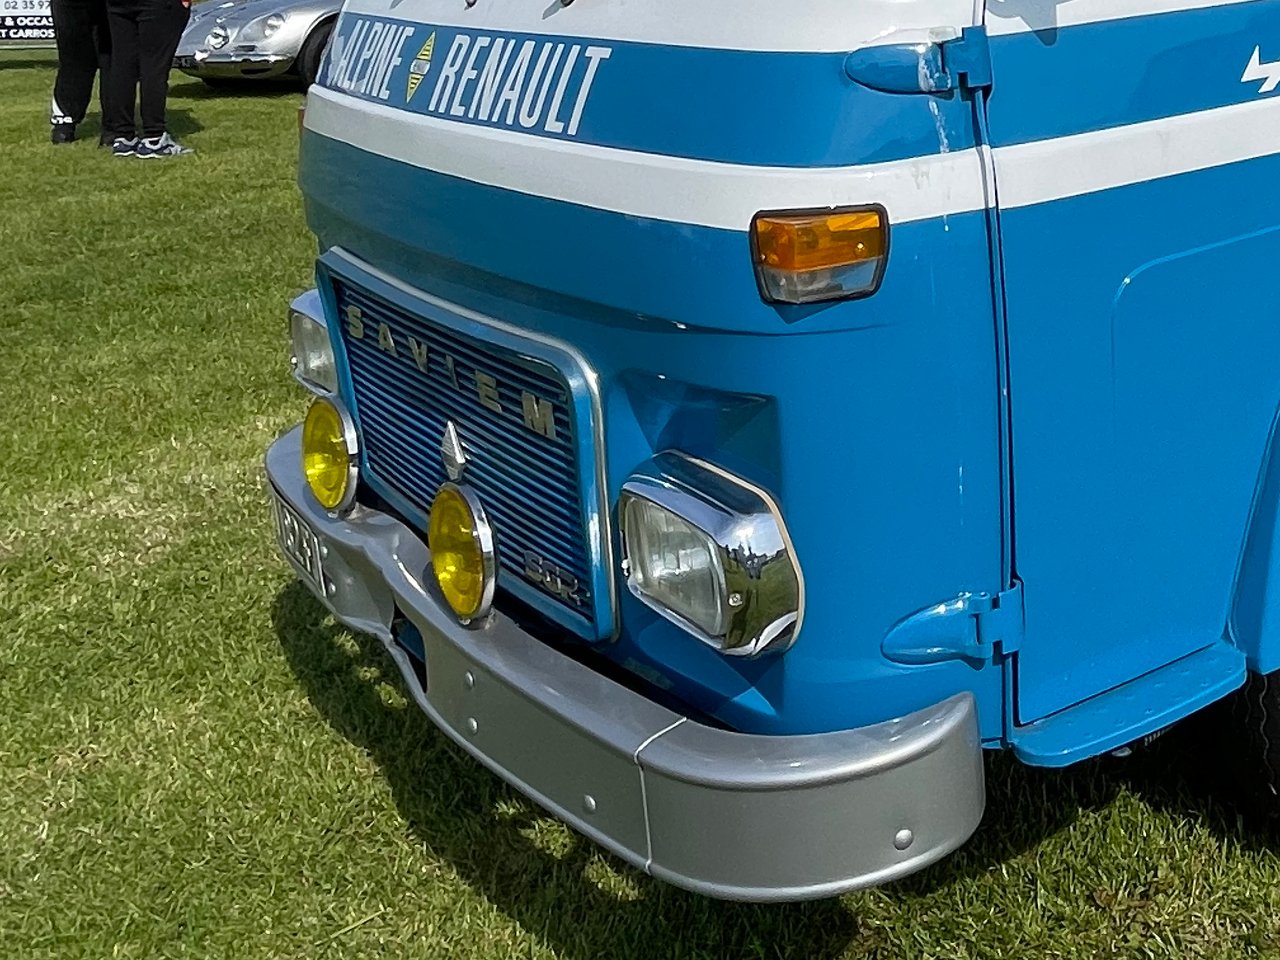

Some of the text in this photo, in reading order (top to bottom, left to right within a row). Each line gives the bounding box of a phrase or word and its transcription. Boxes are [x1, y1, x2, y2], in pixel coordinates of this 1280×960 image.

[4, 0, 18, 10] 02
[22, 0, 35, 10] 35
[331, 19, 612, 136] ALPINE RENAULT
[345, 304, 557, 439] SAVIEM
